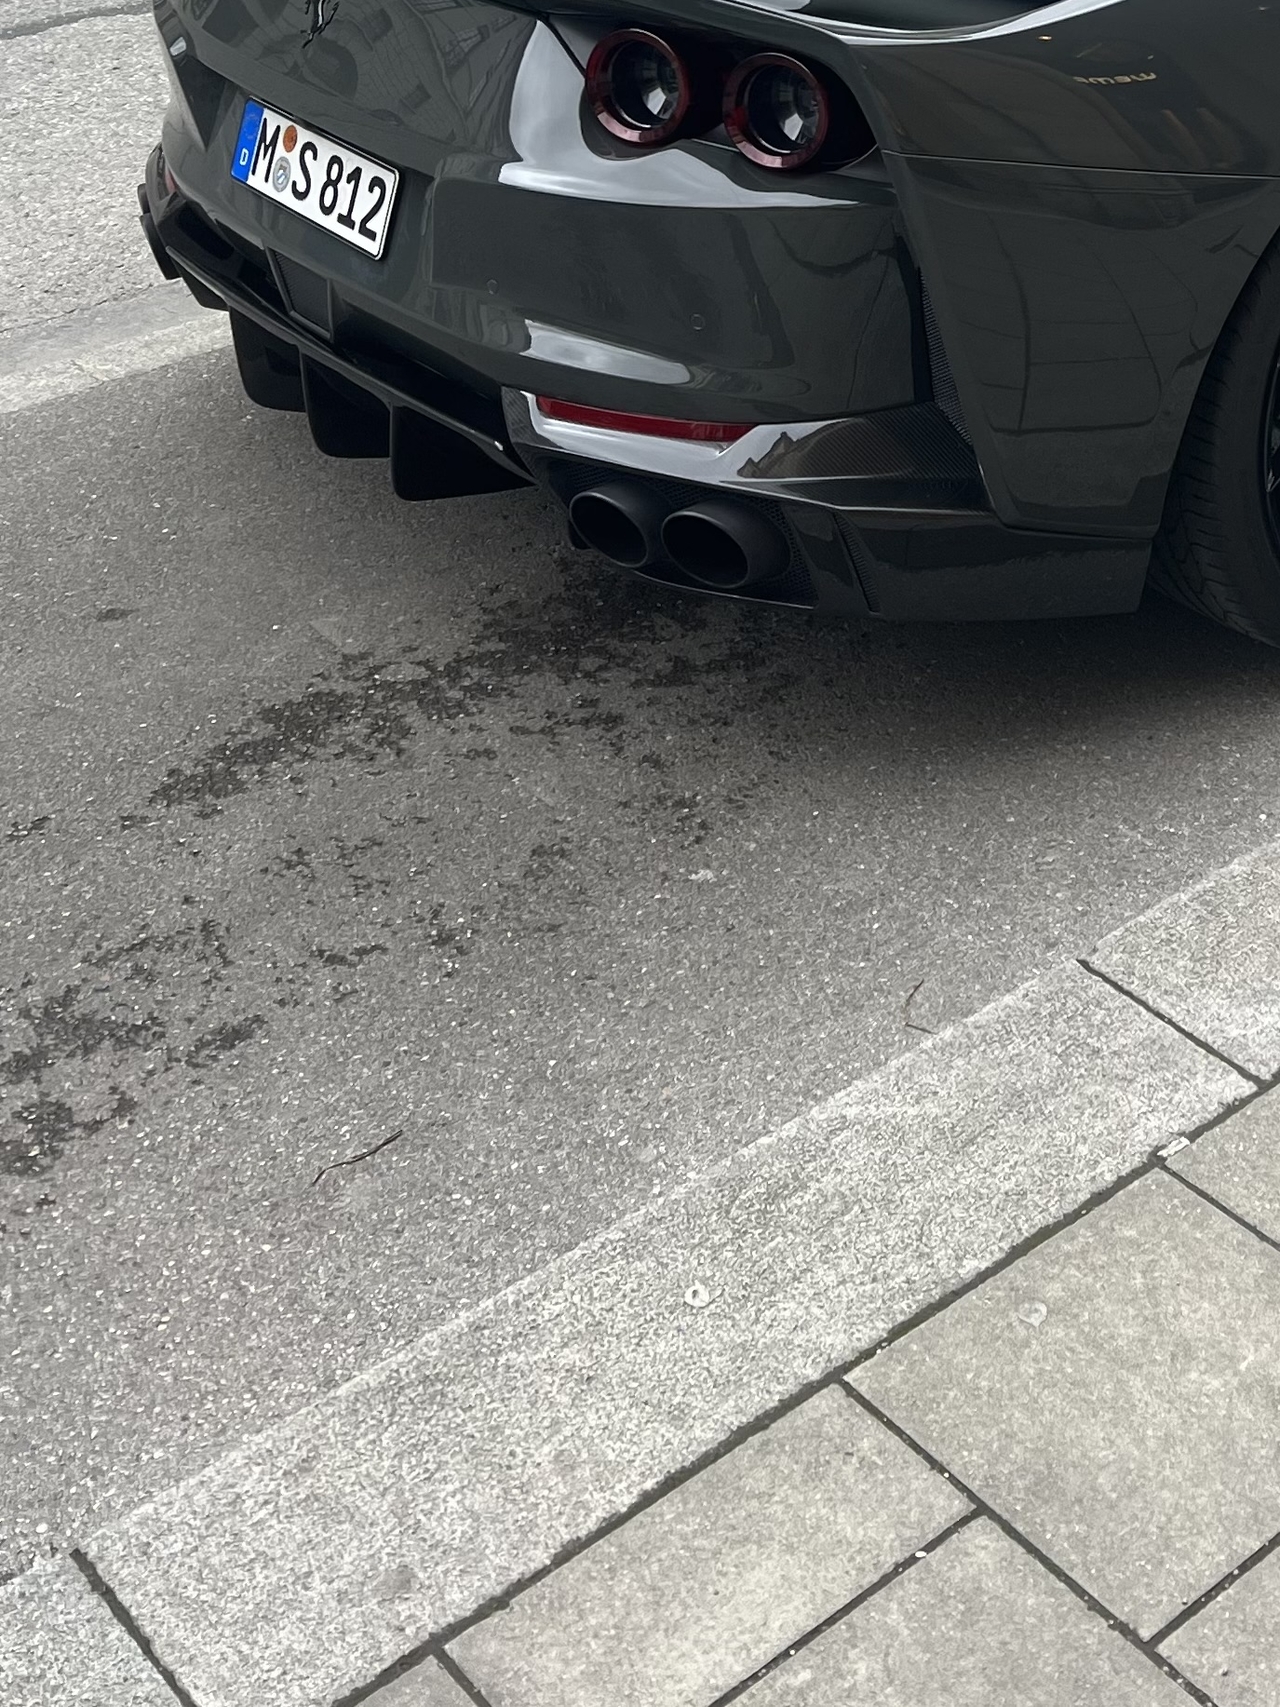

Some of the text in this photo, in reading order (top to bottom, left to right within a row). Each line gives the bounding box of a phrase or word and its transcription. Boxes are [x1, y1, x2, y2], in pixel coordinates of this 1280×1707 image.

[239, 147, 249, 166] D
[251, 117, 387, 242] M S 812
